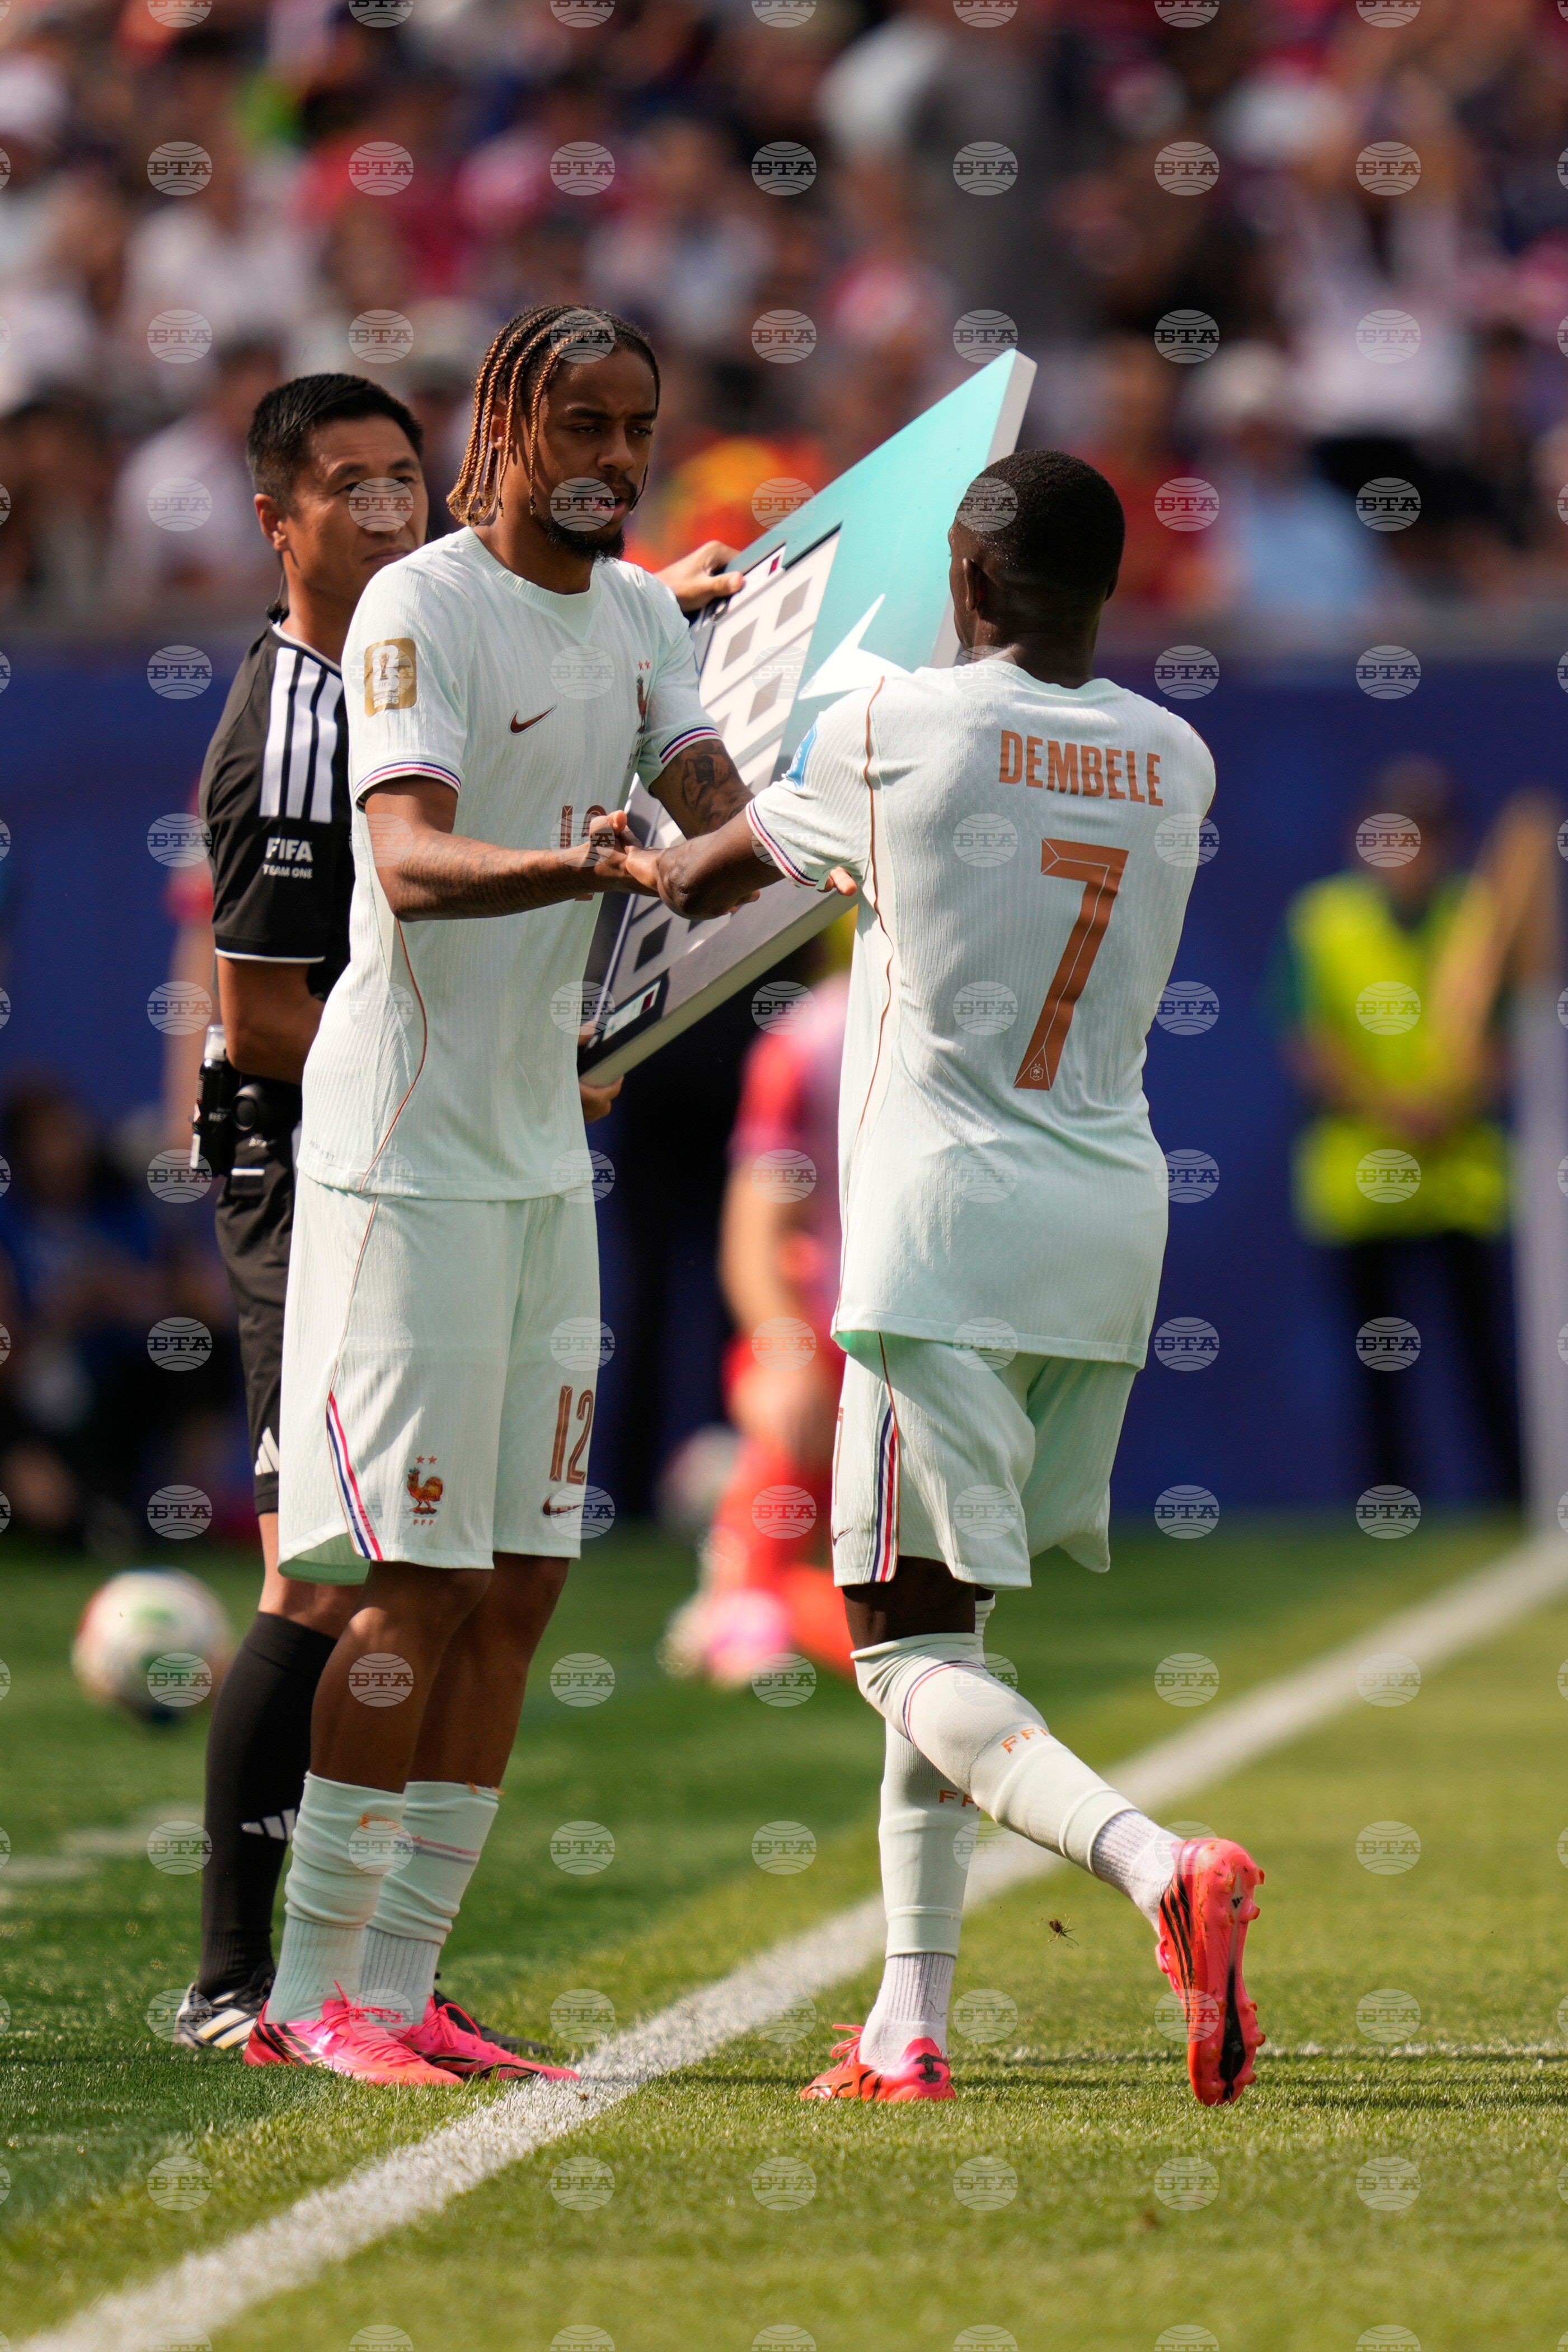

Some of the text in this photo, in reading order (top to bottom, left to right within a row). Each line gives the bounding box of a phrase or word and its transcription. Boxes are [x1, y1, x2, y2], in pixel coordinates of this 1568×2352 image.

[374, 696, 400, 708] 2026
[999, 729, 1163, 807] DEMBELE
[265, 837, 313, 862] FIFA
[263, 864, 313, 879] TEAM ONE
[1013, 837, 1129, 1091] 7
[549, 1385, 594, 1484] 12
[939, 1789, 980, 1811] FF
